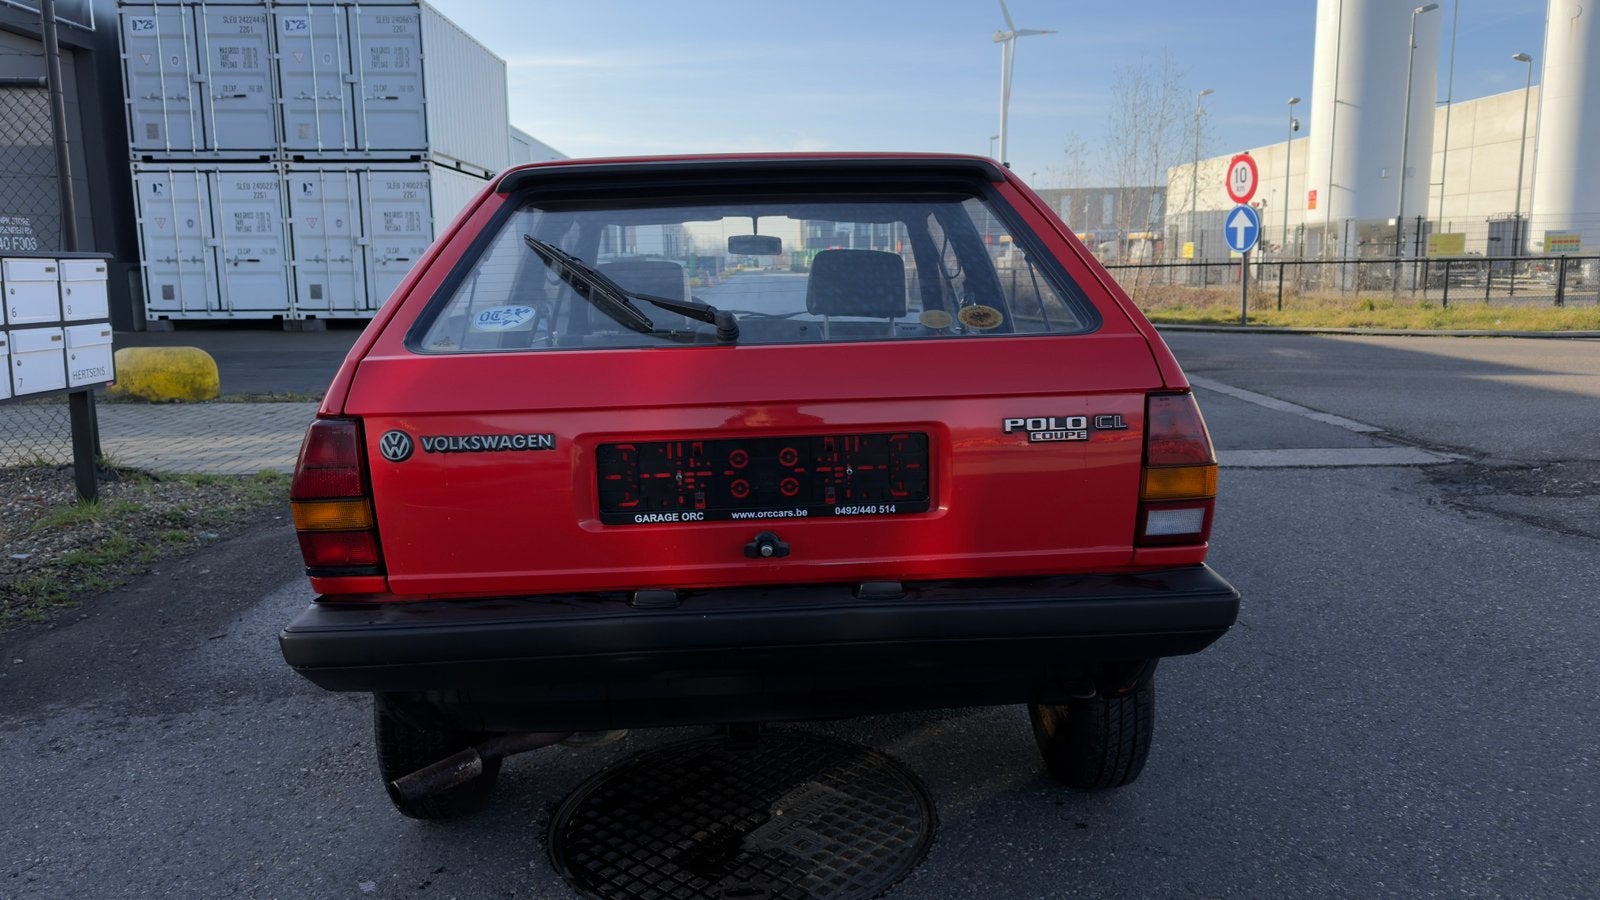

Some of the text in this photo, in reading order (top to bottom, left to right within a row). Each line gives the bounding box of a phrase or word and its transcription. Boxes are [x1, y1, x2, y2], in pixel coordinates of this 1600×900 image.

[1235, 166, 1247, 184] 10
[12, 308, 17, 318] 6
[67, 305, 72, 315] 8
[72, 366, 105, 380] HERTSENS
[18, 378, 23, 388] 7
[1004, 415, 1127, 432] POLO CL
[1032, 430, 1087, 440] COUPE
[422, 434, 552, 450] VOLKSWAGEN
[732, 508, 808, 519] www.orccars.be
[835, 505, 896, 515] 0492/440 514
[634, 512, 704, 523] GARAGE ORC
